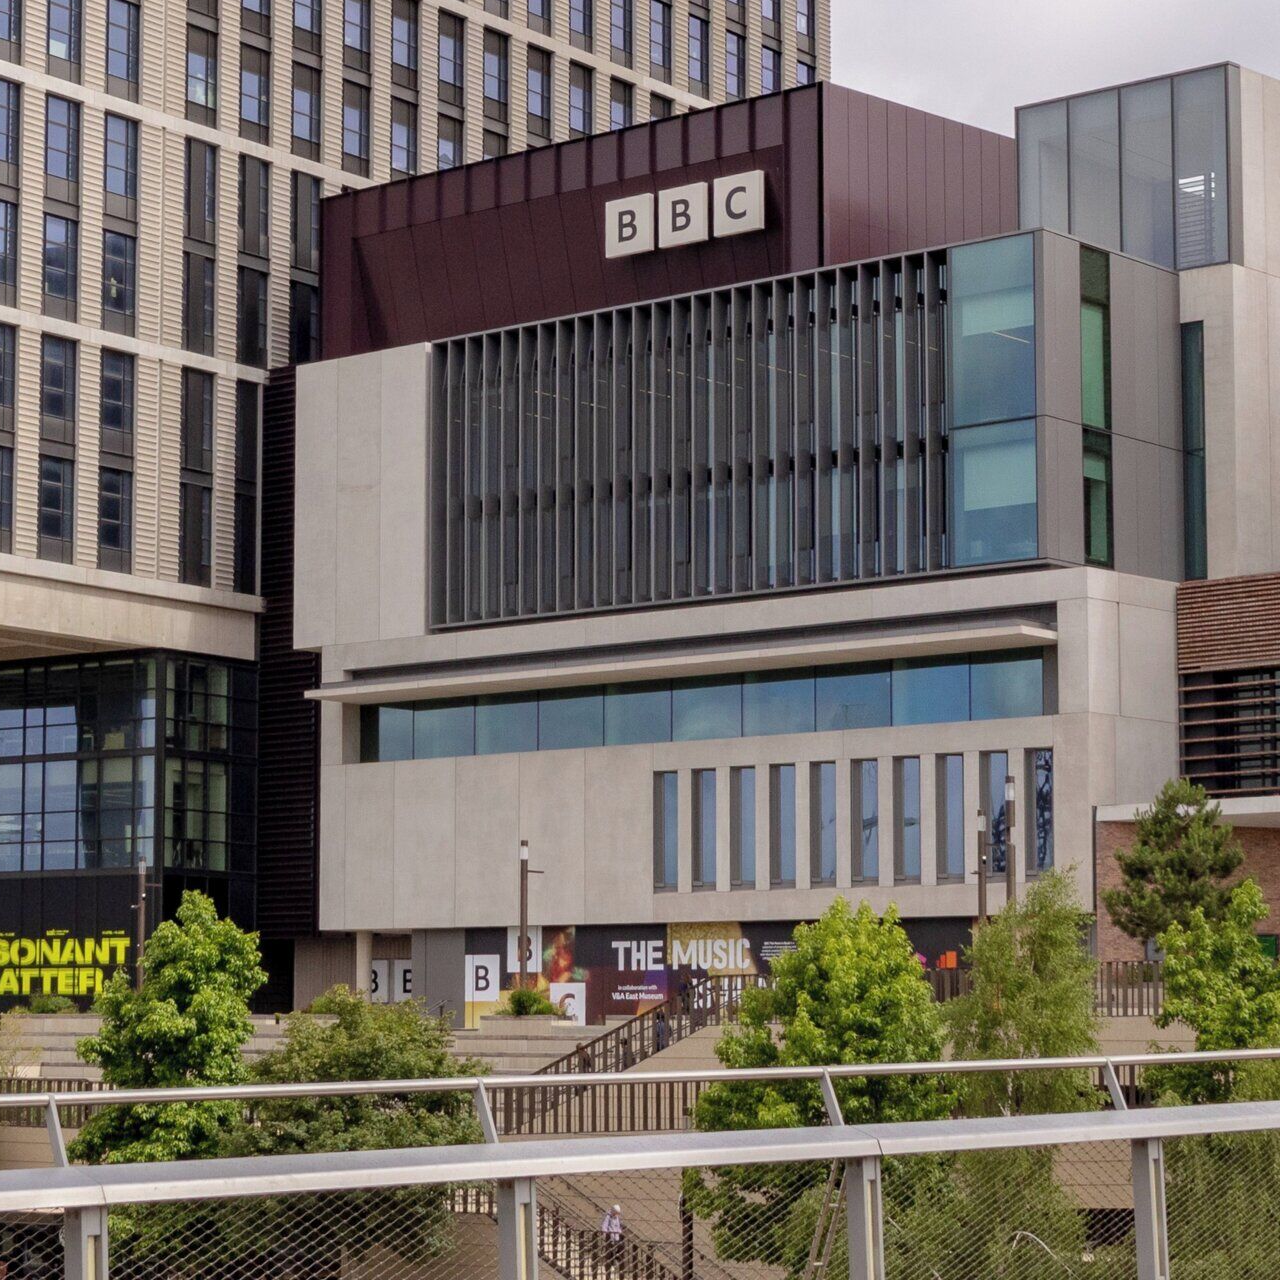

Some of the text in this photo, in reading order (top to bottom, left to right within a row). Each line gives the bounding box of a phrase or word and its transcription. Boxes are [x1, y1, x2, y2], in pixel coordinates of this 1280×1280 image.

[615, 184, 750, 245] BBC
[611, 939, 664, 971] THE
[672, 937, 751, 970] MUSIC
[475, 965, 490, 991] B
[625, 992, 639, 1000] East
[638, 992, 664, 1000] Museum
